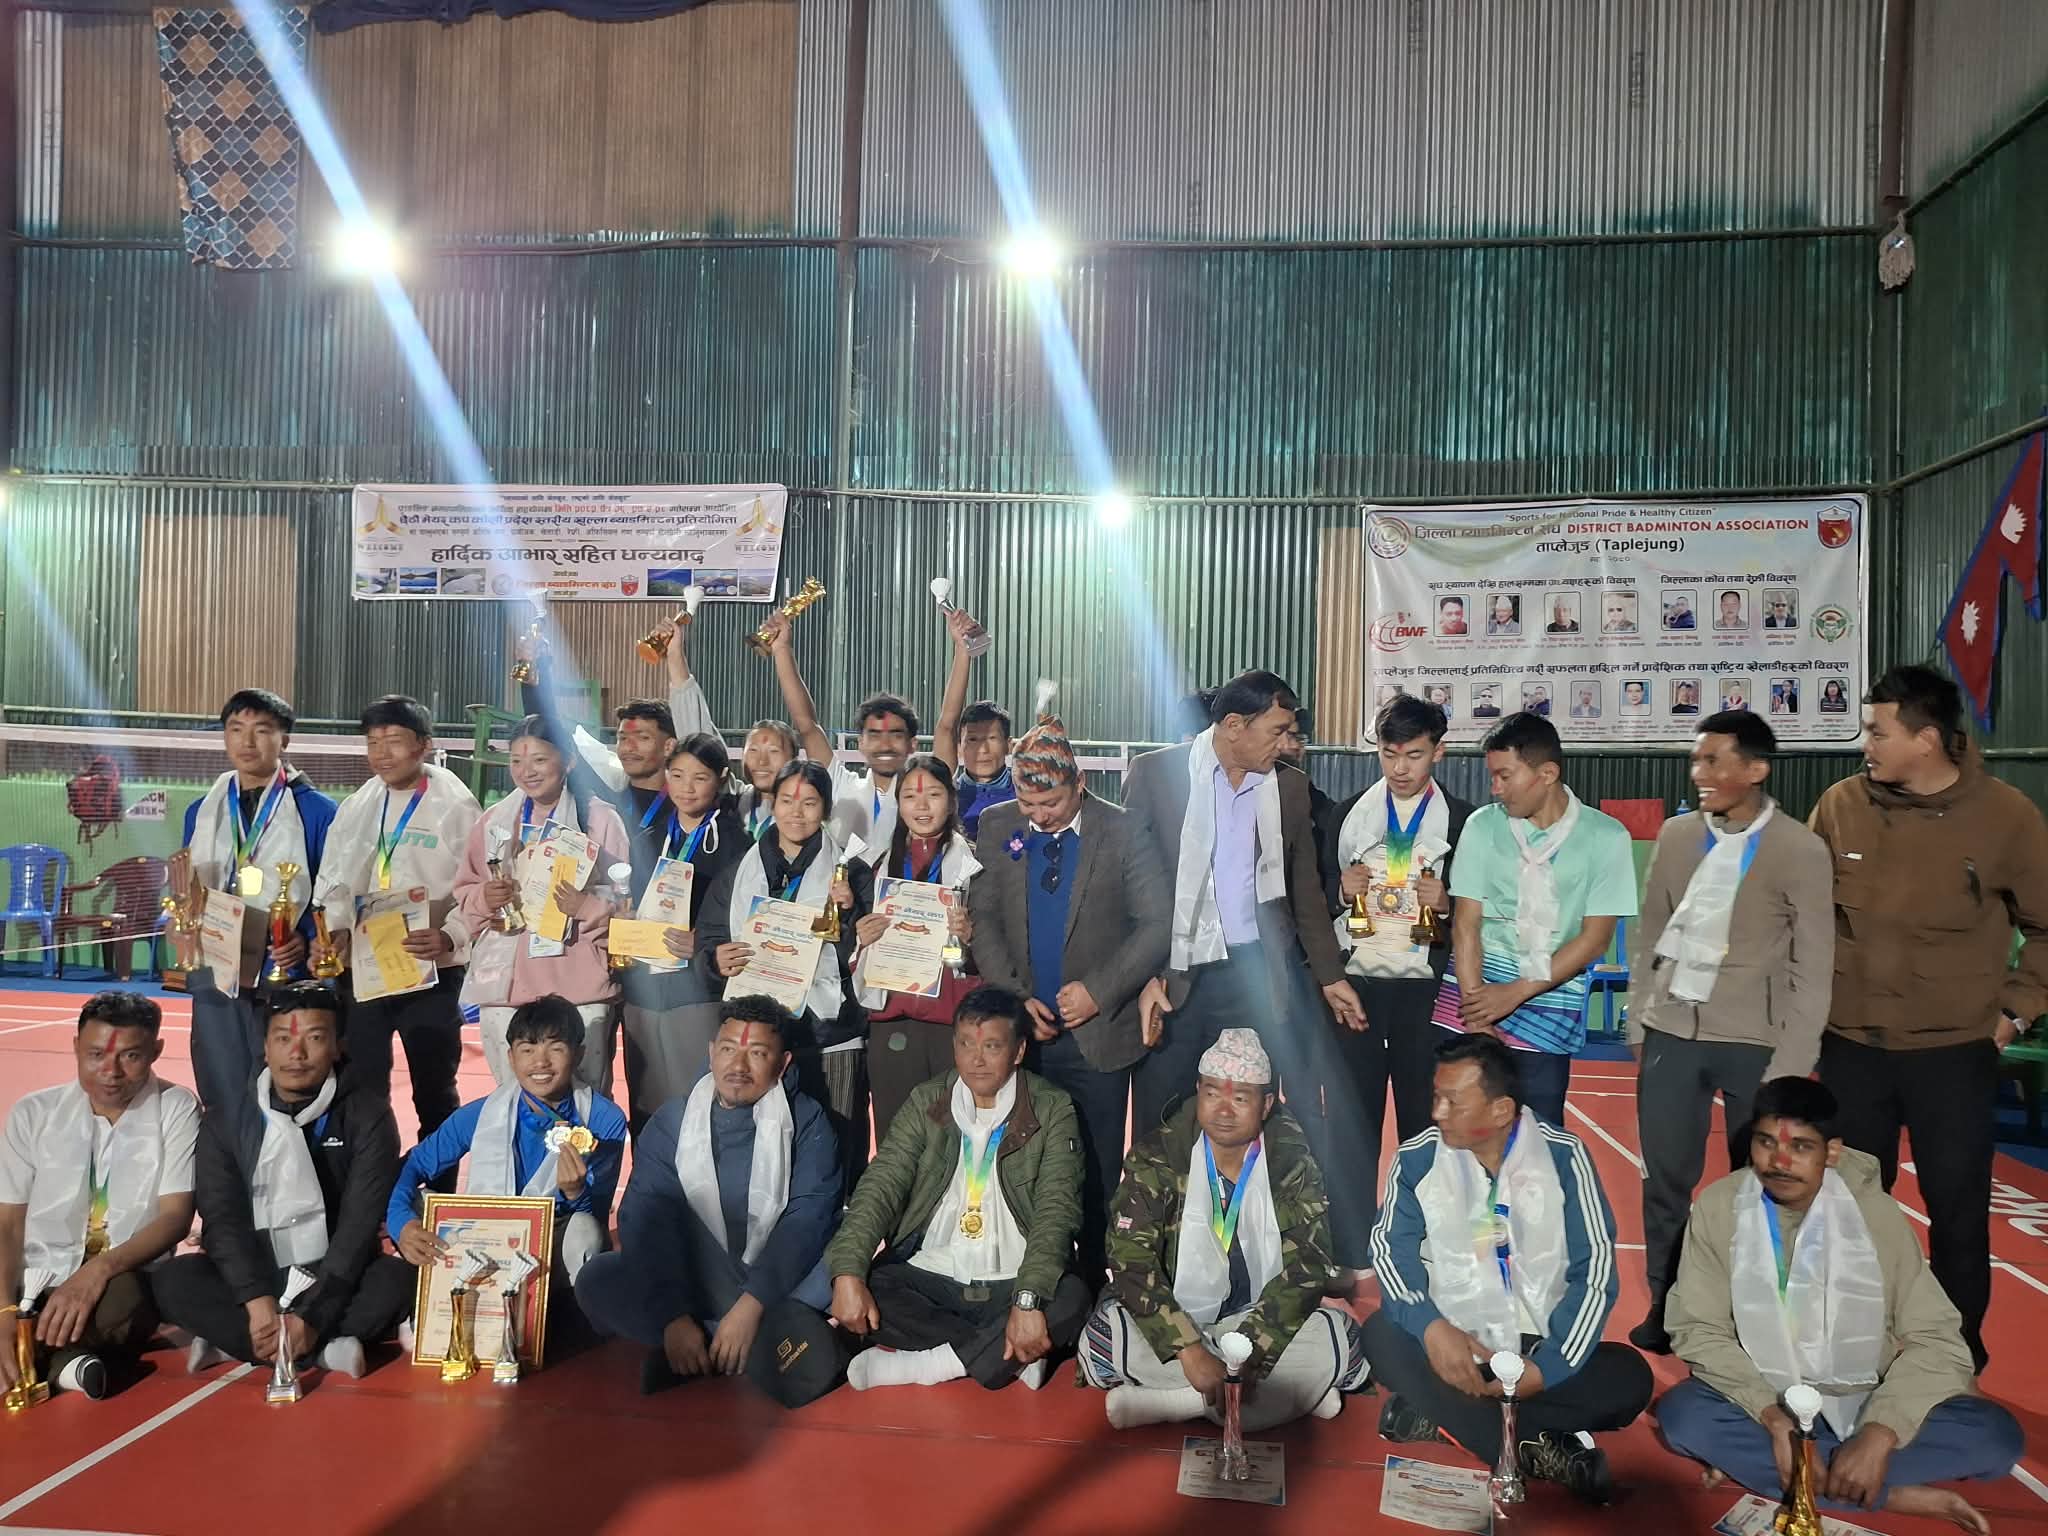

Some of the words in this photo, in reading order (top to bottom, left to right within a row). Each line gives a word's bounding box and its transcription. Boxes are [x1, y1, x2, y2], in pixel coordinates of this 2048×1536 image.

[1601, 509, 1627, 518] Pride
[1629, 509, 1637, 517] &
[1639, 508, 1676, 519] Healthy
[1415, 525, 1456, 539] जिल्ला
[1567, 522, 1622, 534] DISTRICT
[1626, 520, 1712, 533] BADMINTON
[1714, 518, 1809, 531] ASSOCIATION
[1536, 538, 1590, 554] ताप्लेजुङ
[1595, 537, 1685, 553] (Taplejung)
[431, 544, 492, 564] हार्दिक
[563, 544, 617, 564] सहित
[621, 549, 706, 564] धन्यवाद
[1606, 575, 1636, 586] विवरण
[1766, 573, 1797, 584] विवरण
[1395, 626, 1428, 638] BWF
[1546, 663, 1587, 675] सफलता
[1688, 662, 1710, 671] तथा
[1814, 659, 1849, 673] विवरण
